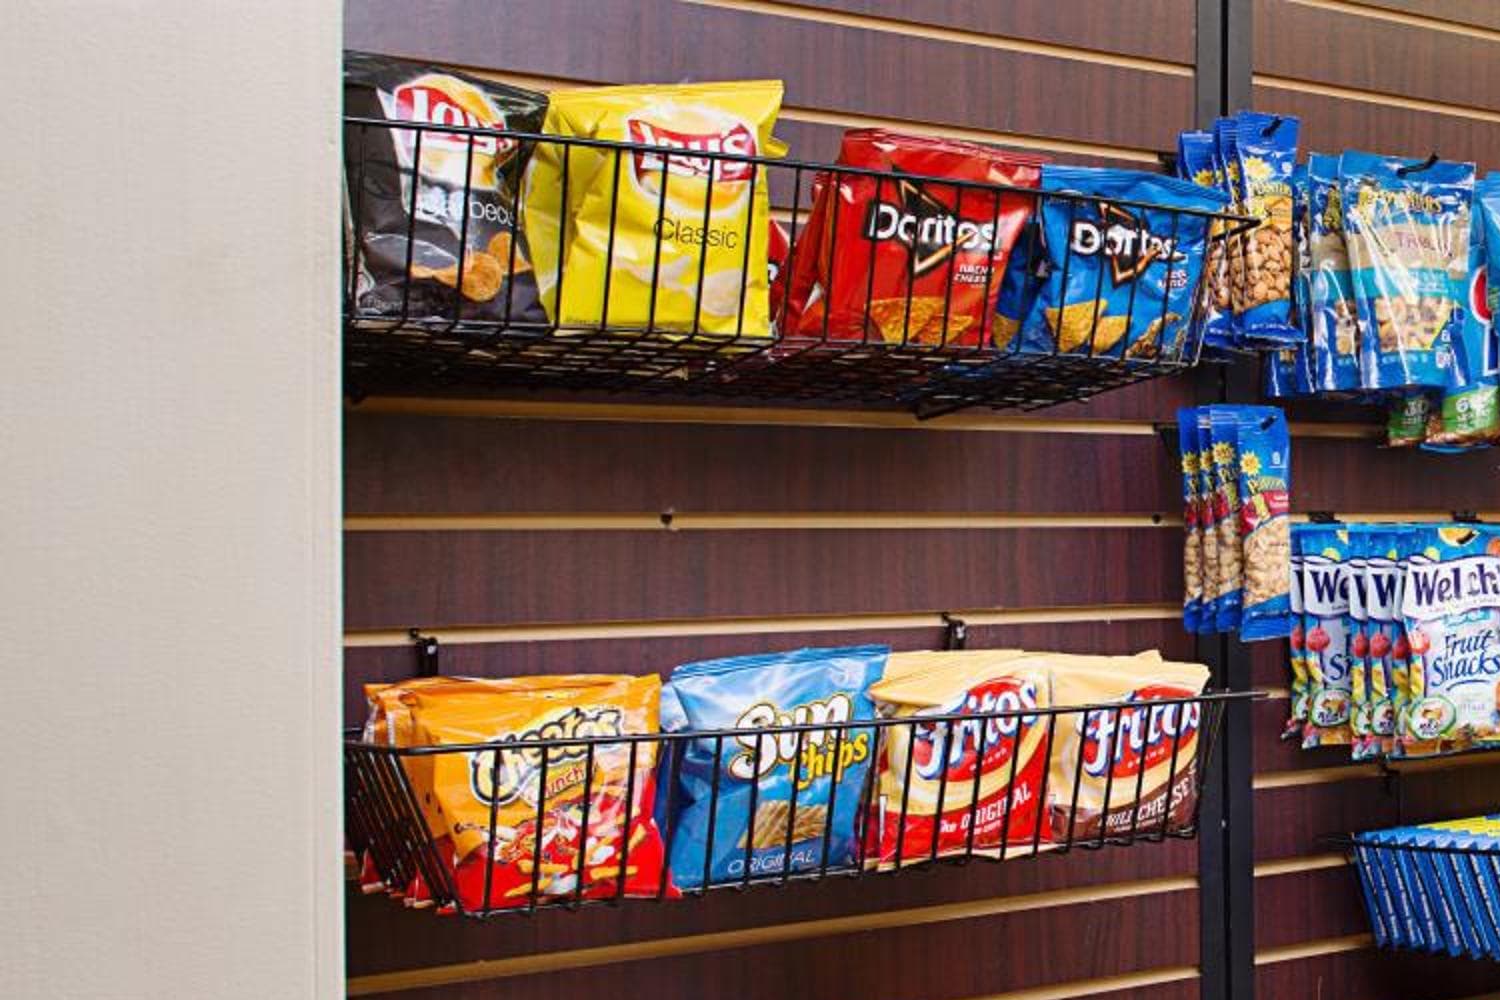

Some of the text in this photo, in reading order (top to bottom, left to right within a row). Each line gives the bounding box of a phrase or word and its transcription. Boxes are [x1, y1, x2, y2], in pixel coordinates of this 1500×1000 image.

[653, 217, 738, 249] Classic
[1070, 221, 1178, 260] Dortos
[1443, 629, 1495, 661] Fruit
[729, 692, 852, 782] Sun
